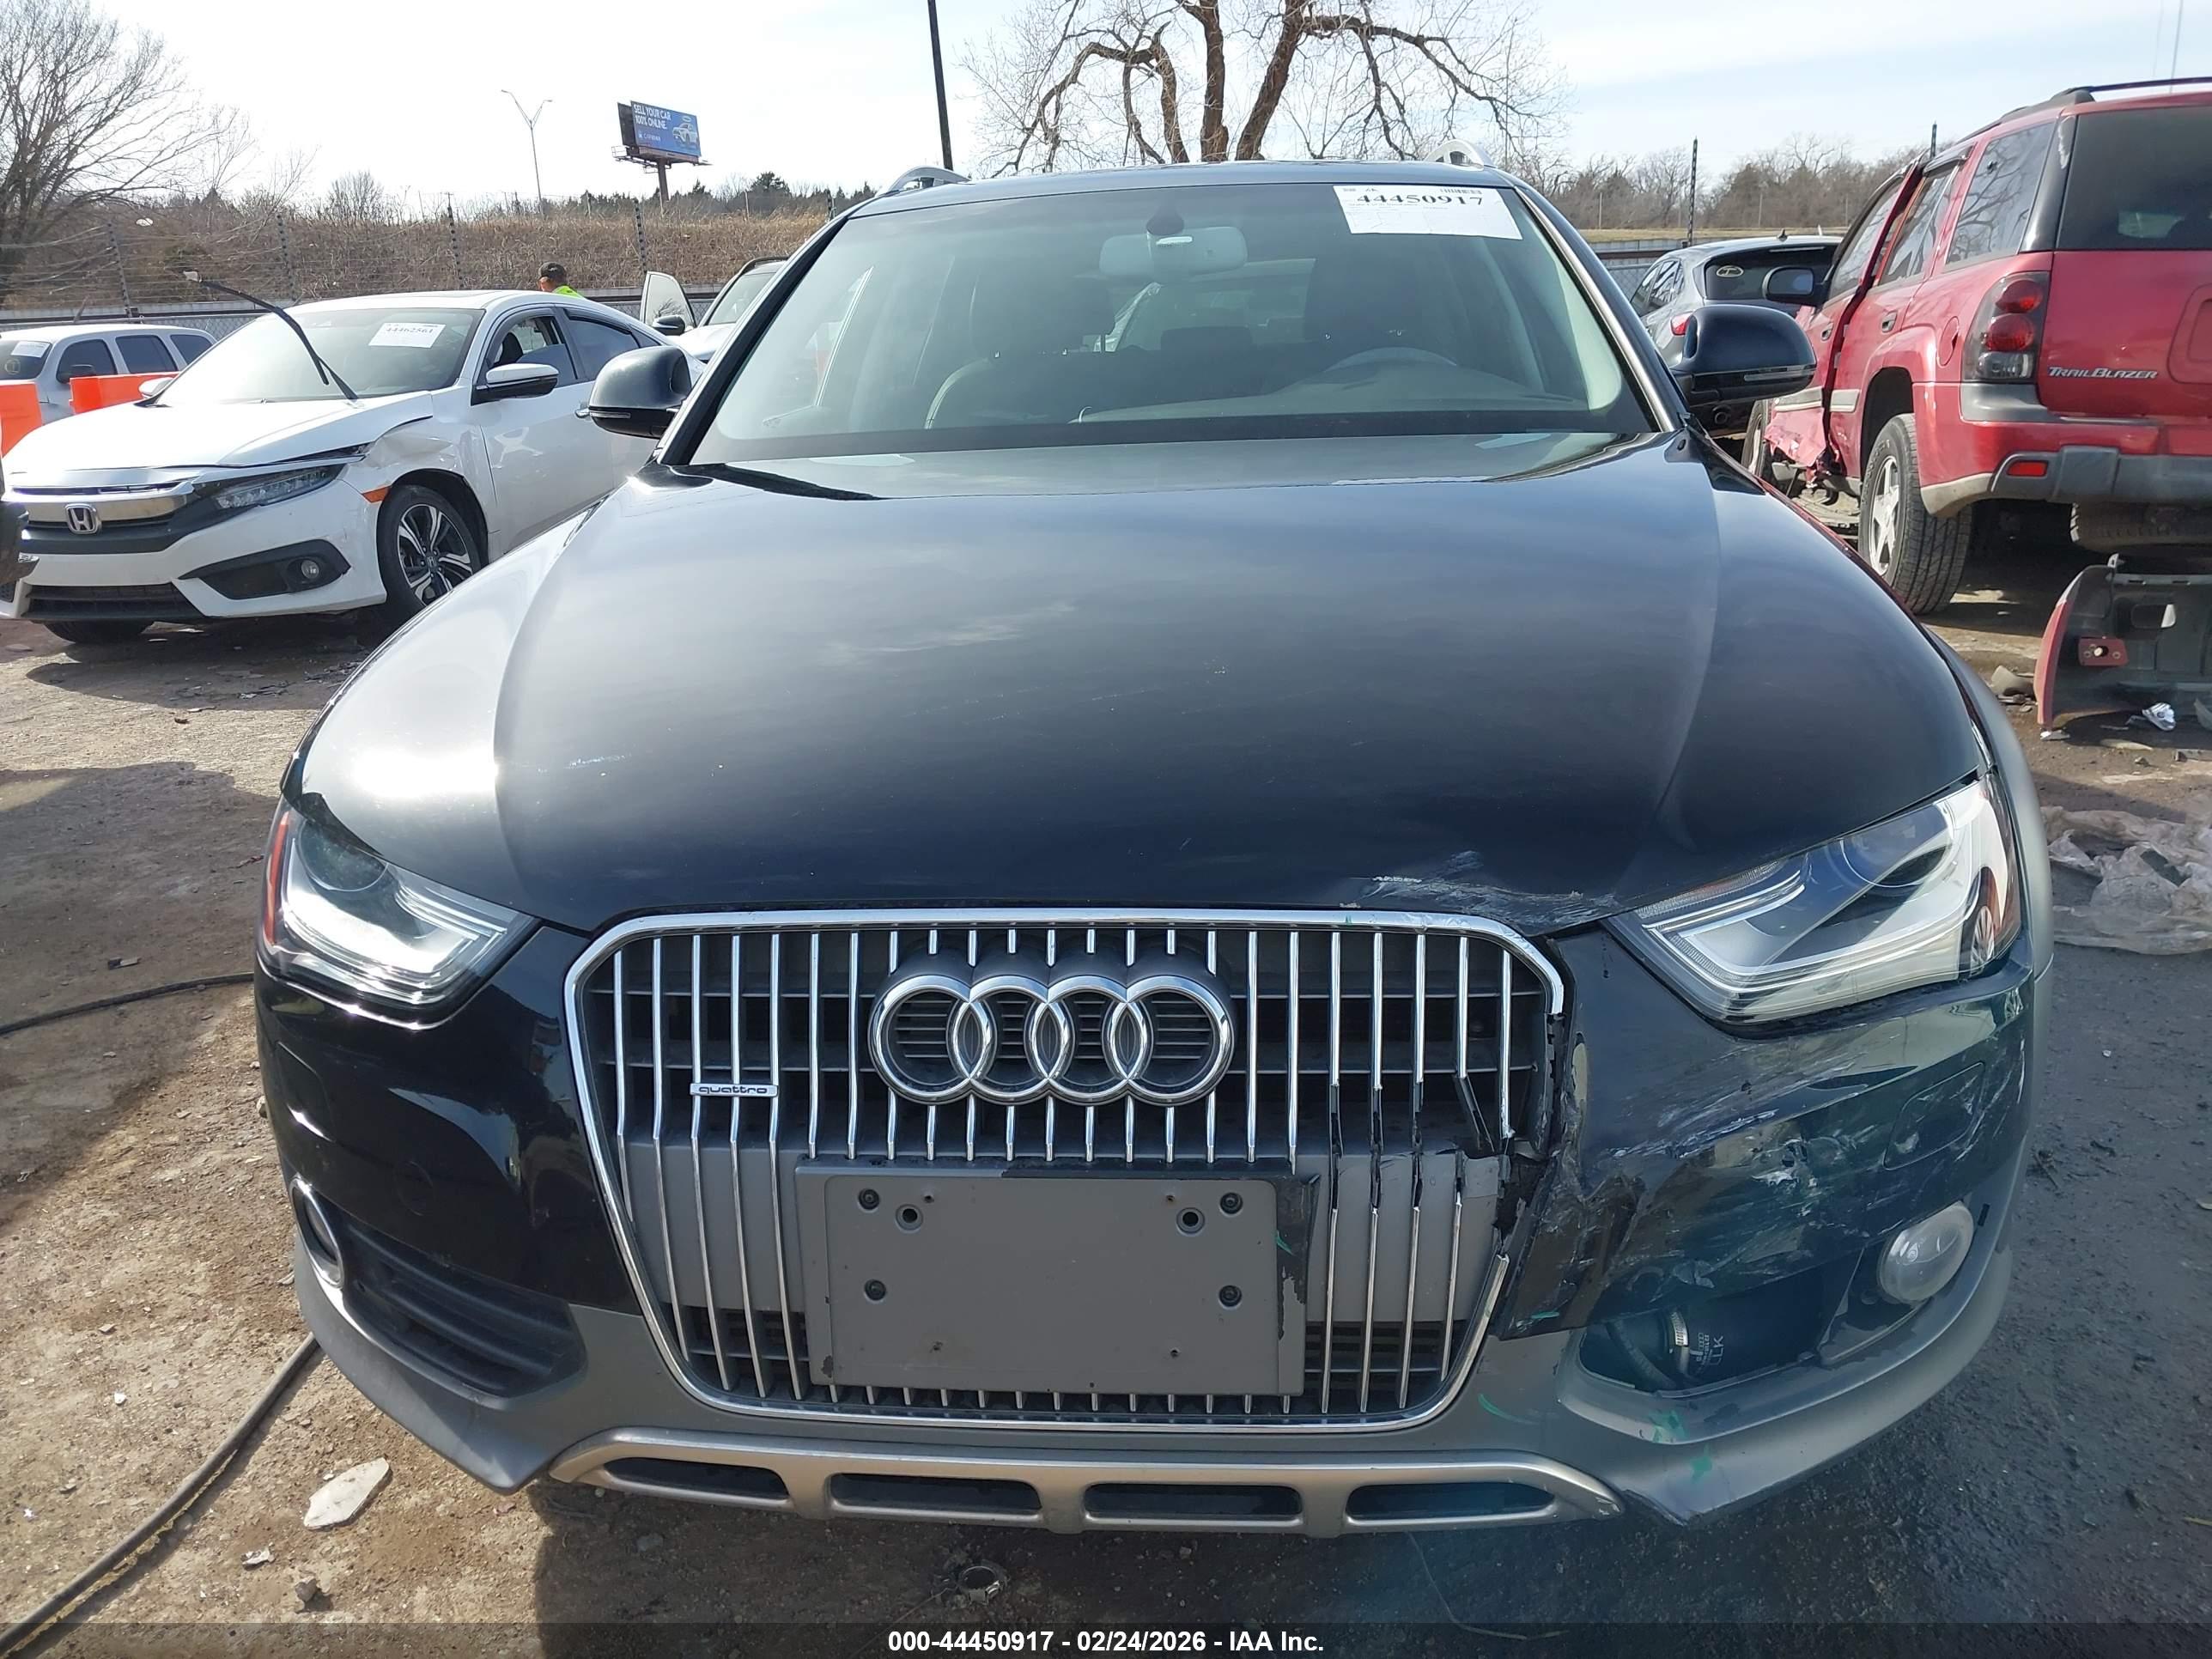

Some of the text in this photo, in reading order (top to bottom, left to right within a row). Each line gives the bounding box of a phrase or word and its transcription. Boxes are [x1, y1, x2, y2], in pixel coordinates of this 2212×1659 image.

[634, 104, 672, 120] SELL YOUR CAR
[635, 115, 647, 126] 100%
[1357, 194, 1483, 205] 44450917
[2049, 367, 2158, 379] TRAILBLAZER
[698, 1085, 768, 1095] quattro
